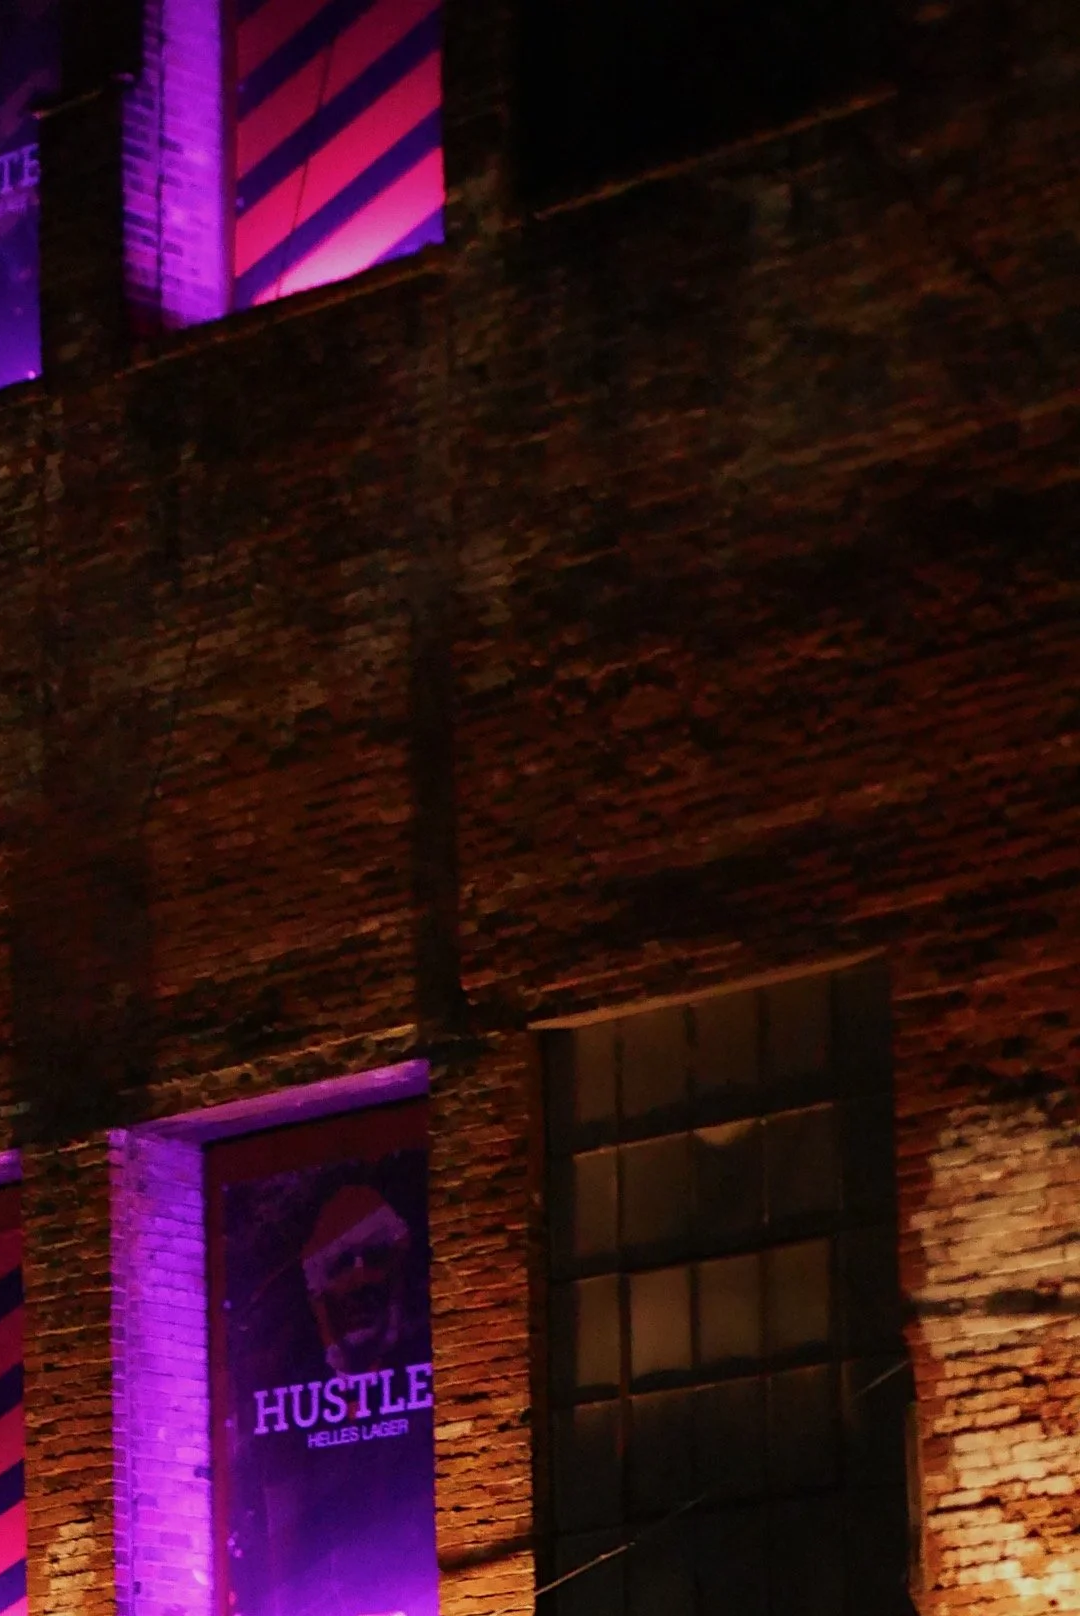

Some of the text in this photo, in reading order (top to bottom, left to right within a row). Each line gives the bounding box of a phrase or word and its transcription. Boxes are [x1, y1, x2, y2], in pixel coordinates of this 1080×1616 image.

[253, 1362, 434, 1436] HUSTLE
[307, 1418, 410, 1449] HELLES LAGER
